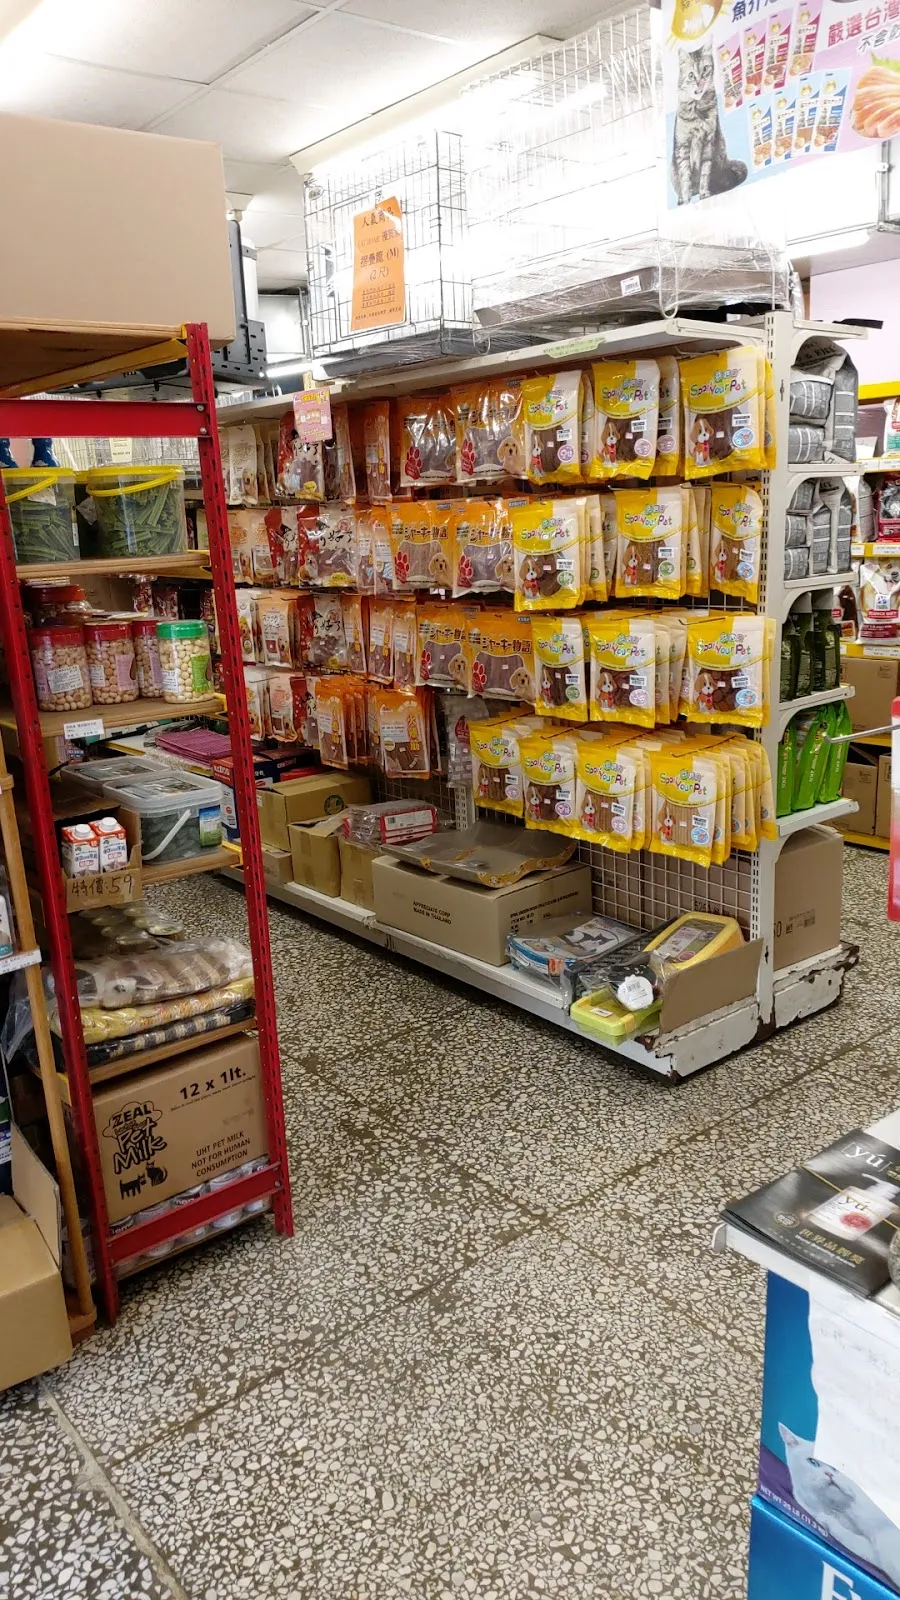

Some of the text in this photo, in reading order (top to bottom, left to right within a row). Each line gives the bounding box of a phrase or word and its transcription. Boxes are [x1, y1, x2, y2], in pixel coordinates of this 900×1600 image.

[482, 636, 532, 655] ジャーキー物語
[413, 900, 438, 914] APPRECIATE
[413, 907, 425, 915] MADE
[431, 912, 452, 925] THAILAND
[180, 1066, 246, 1099] 12 x 1lt.
[112, 1104, 152, 1128] ZEAL
[117, 1117, 158, 1155] Pet
[196, 1130, 245, 1157] UHT PET MILK
[113, 1135, 168, 1175] Milk
[191, 1137, 251, 1170] NOT FOR HUMAN
[196, 1149, 248, 1177] CONSUMPTION
[760, 1484, 771, 1497] NET
[772, 1491, 782, 1504] WT
[782, 1500, 791, 1511] 25
